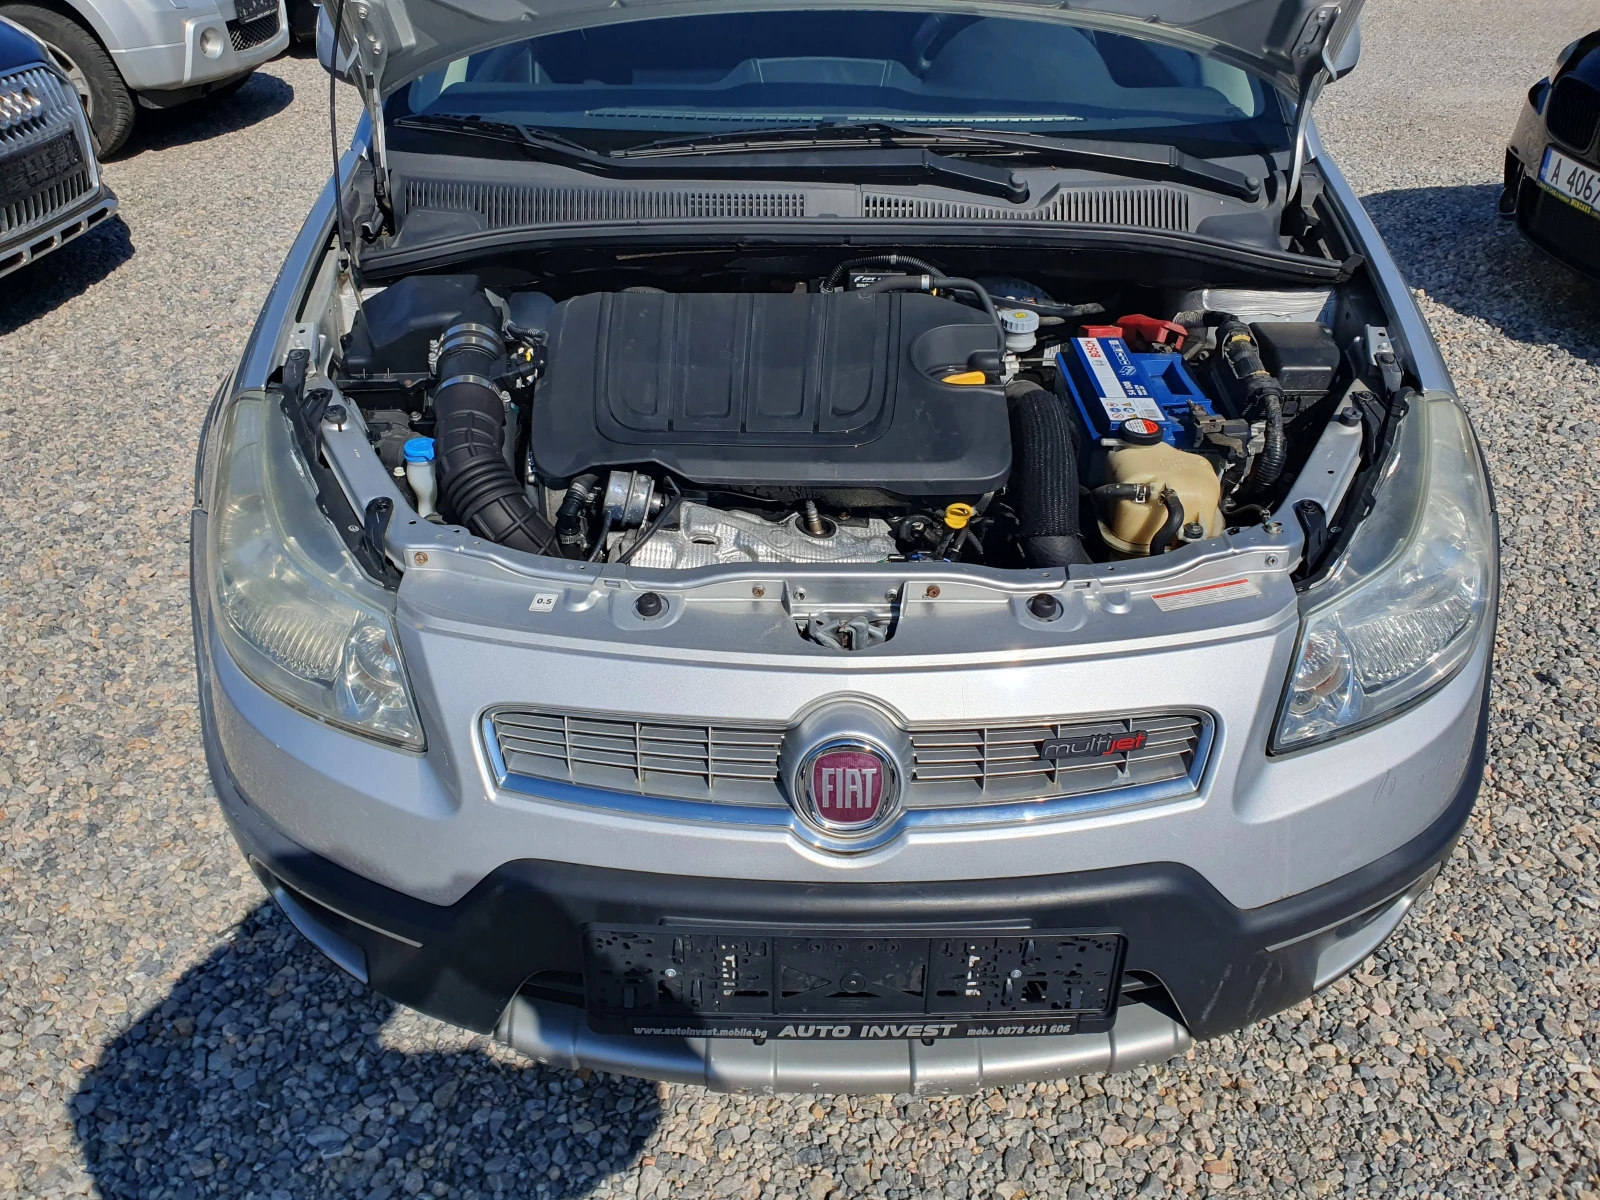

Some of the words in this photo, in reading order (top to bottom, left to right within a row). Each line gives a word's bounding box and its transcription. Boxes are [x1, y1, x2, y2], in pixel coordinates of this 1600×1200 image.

[1550, 158, 1562, 185] A
[1083, 340, 1101, 357] BOSCH
[1045, 733, 1146, 755] multijet
[822, 768, 877, 808] FIAT
[633, 1026, 767, 1038] www.autoinvest.mobile.bg
[777, 1025, 852, 1037] AUTO
[860, 1024, 957, 1037] INVEST
[997, 1026, 1024, 1035] 0878
[1026, 1026, 1046, 1034] 441
